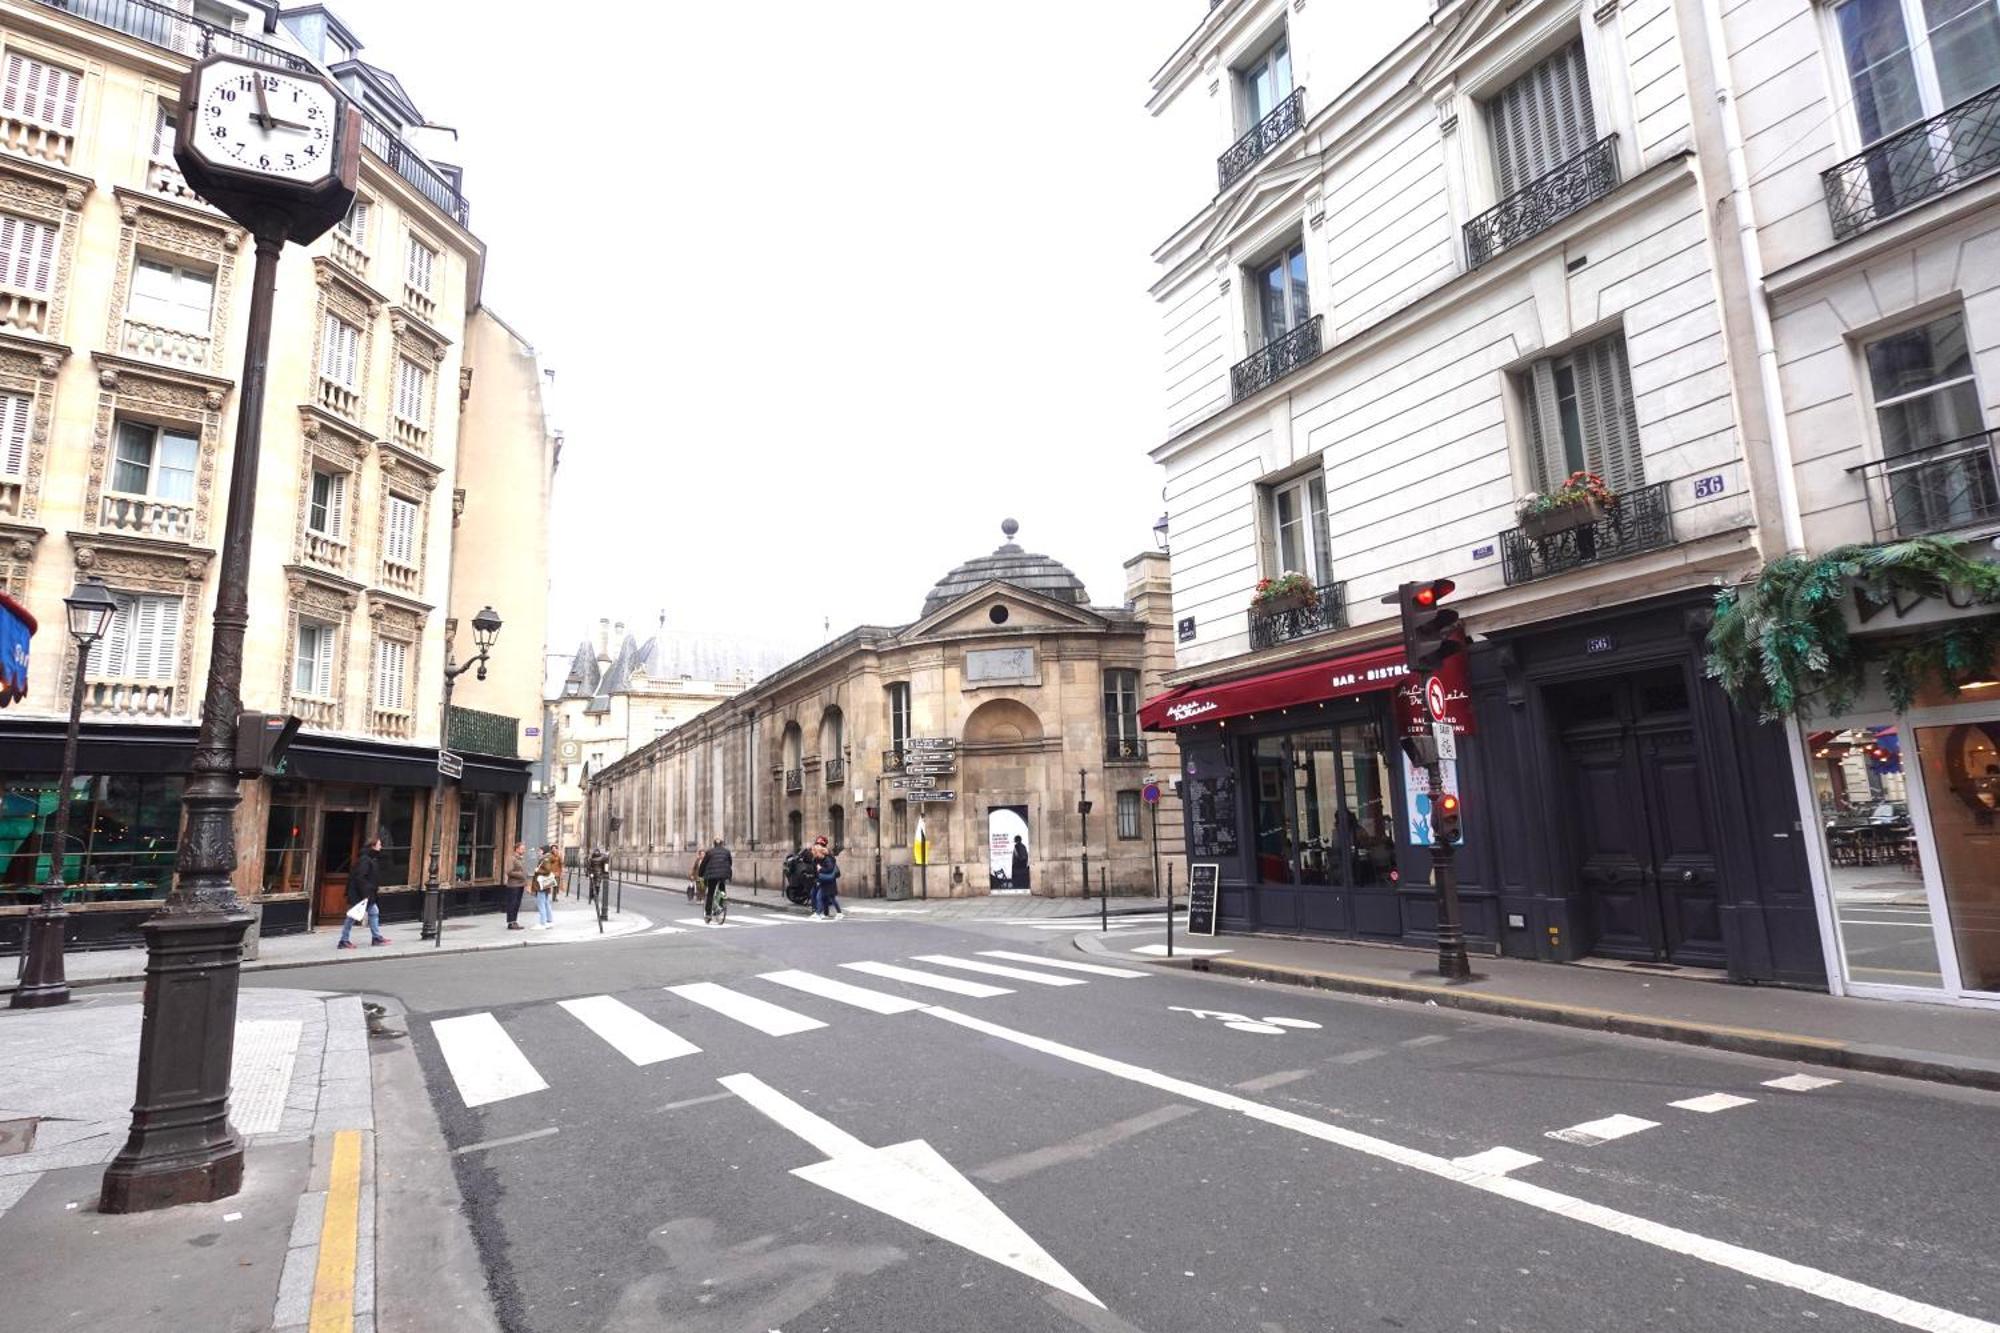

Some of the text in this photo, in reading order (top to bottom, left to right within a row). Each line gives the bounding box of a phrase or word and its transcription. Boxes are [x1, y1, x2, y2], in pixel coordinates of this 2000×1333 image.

[240, 79, 252, 92] 11
[263, 79, 279, 92] 12
[220, 89, 236, 102] 10
[293, 91, 298, 103] 1
[211, 106, 221, 117] 9
[308, 107, 317, 119] 2
[216, 127, 227, 138] 8
[314, 128, 323, 139] 3
[236, 142, 245, 155] 7
[304, 145, 315, 156] 4
[260, 154, 270, 167] 6
[285, 154, 294, 165] 5
[1696, 476, 1721, 497] 56
[1591, 639, 1607, 650] 56
[1332, 674, 1355, 687] BAR
